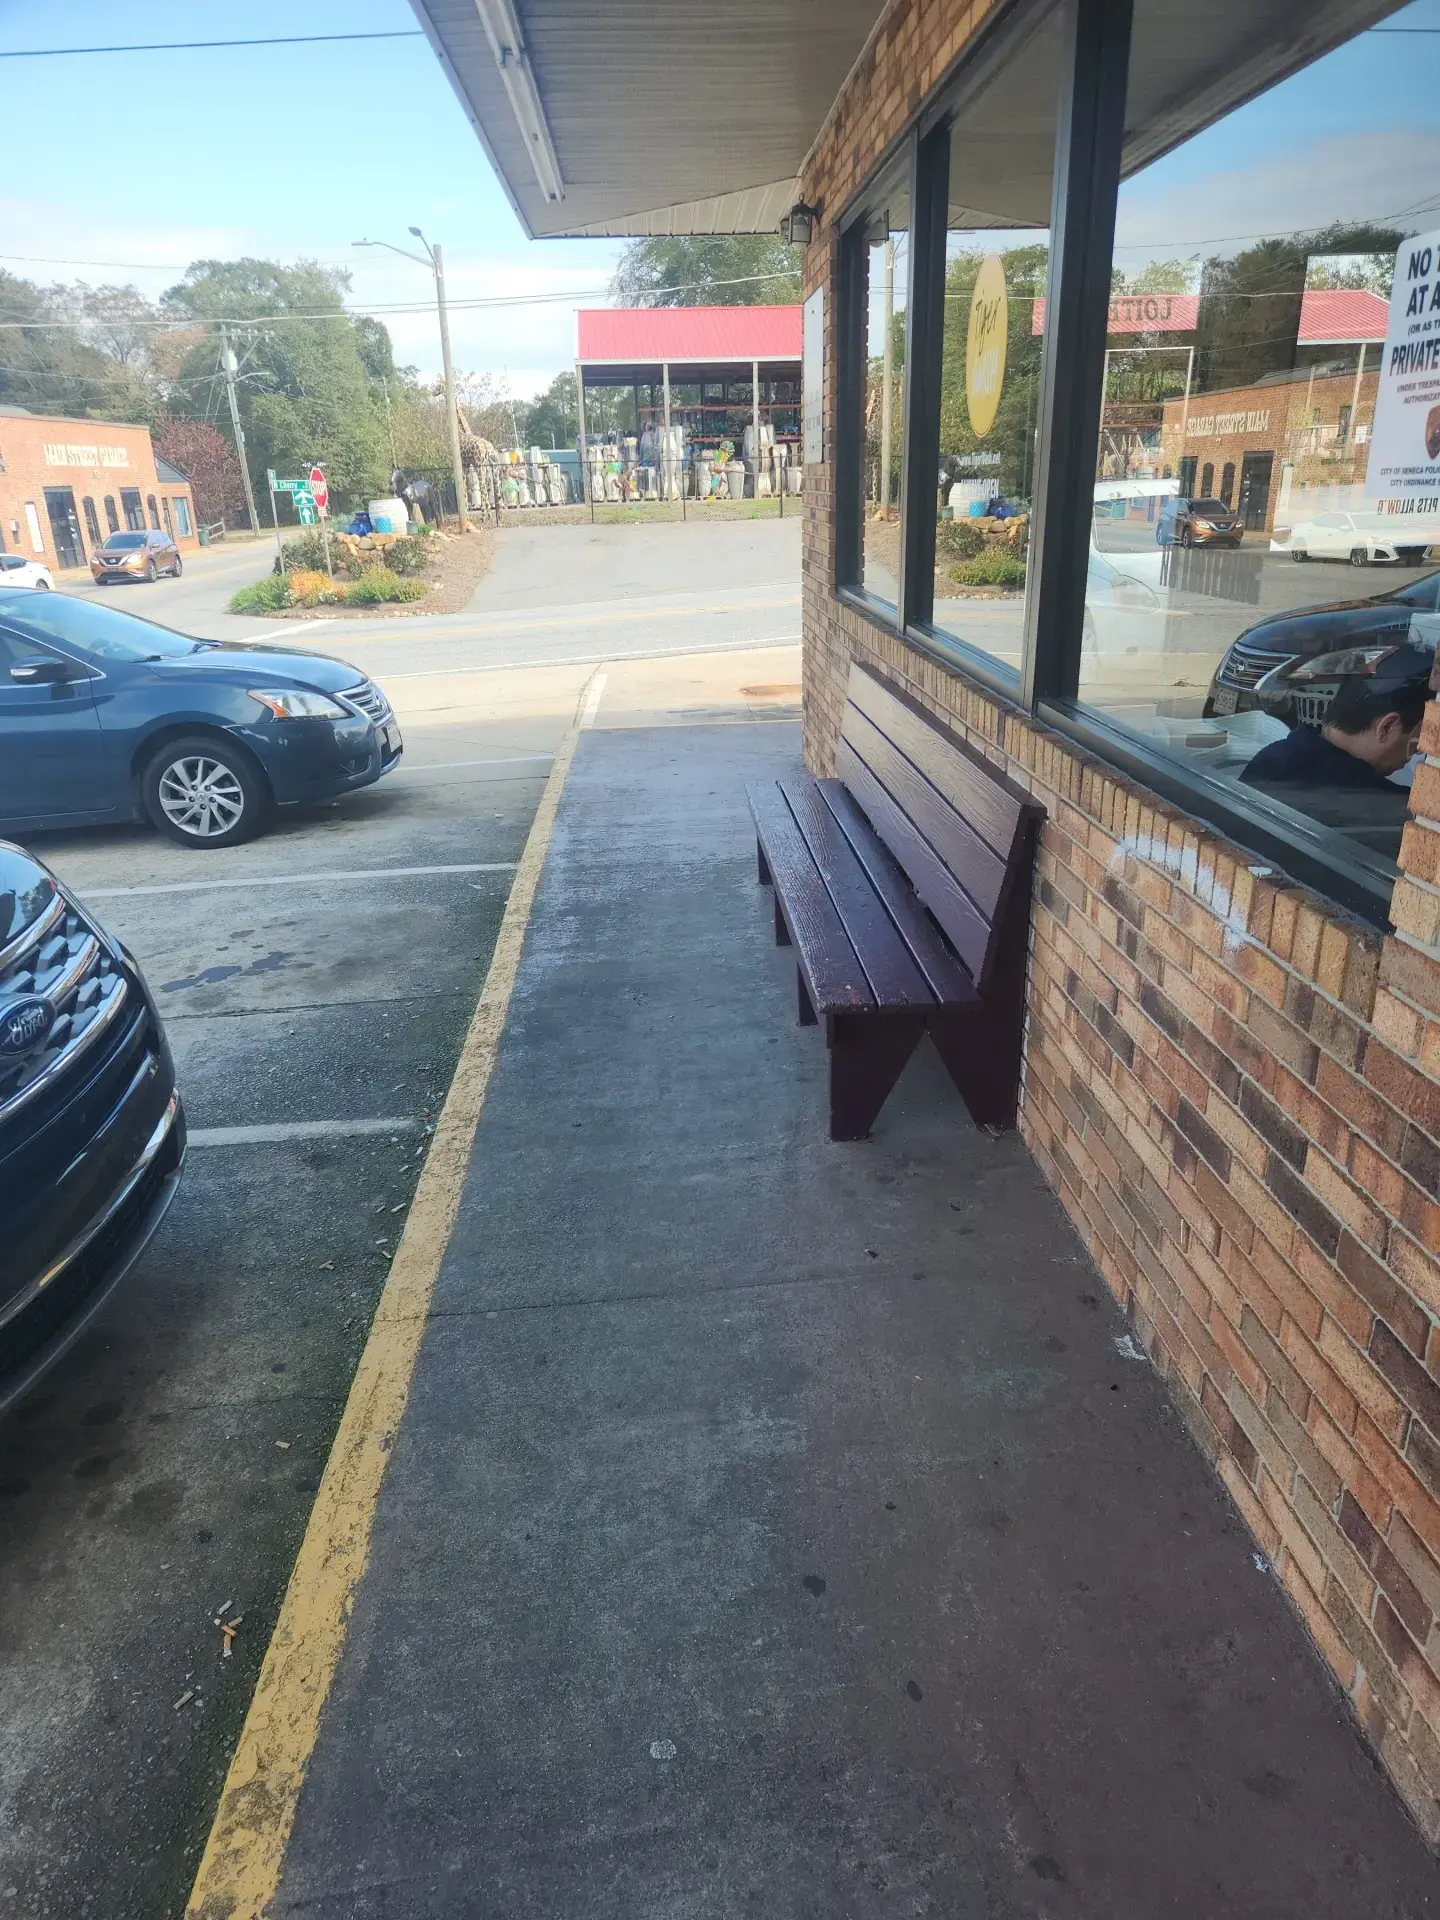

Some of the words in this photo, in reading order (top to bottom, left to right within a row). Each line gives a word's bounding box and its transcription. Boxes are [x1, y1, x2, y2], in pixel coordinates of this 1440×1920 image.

[1408, 247, 1432, 281] NO
[1406, 284, 1429, 317] AT
[1422, 320, 1432, 333] AS
[1389, 338, 1440, 377] PRIVATE
[1396, 382, 1417, 393] UNDER
[1380, 467, 1392, 476] CITY
[1393, 467, 1401, 475] OF
[311, 480, 326, 496] STOP
[1390, 479, 1402, 487] CITY
[1403, 478, 1437, 487] ORDINANCE
[8, 1005, 47, 1045] Ford
